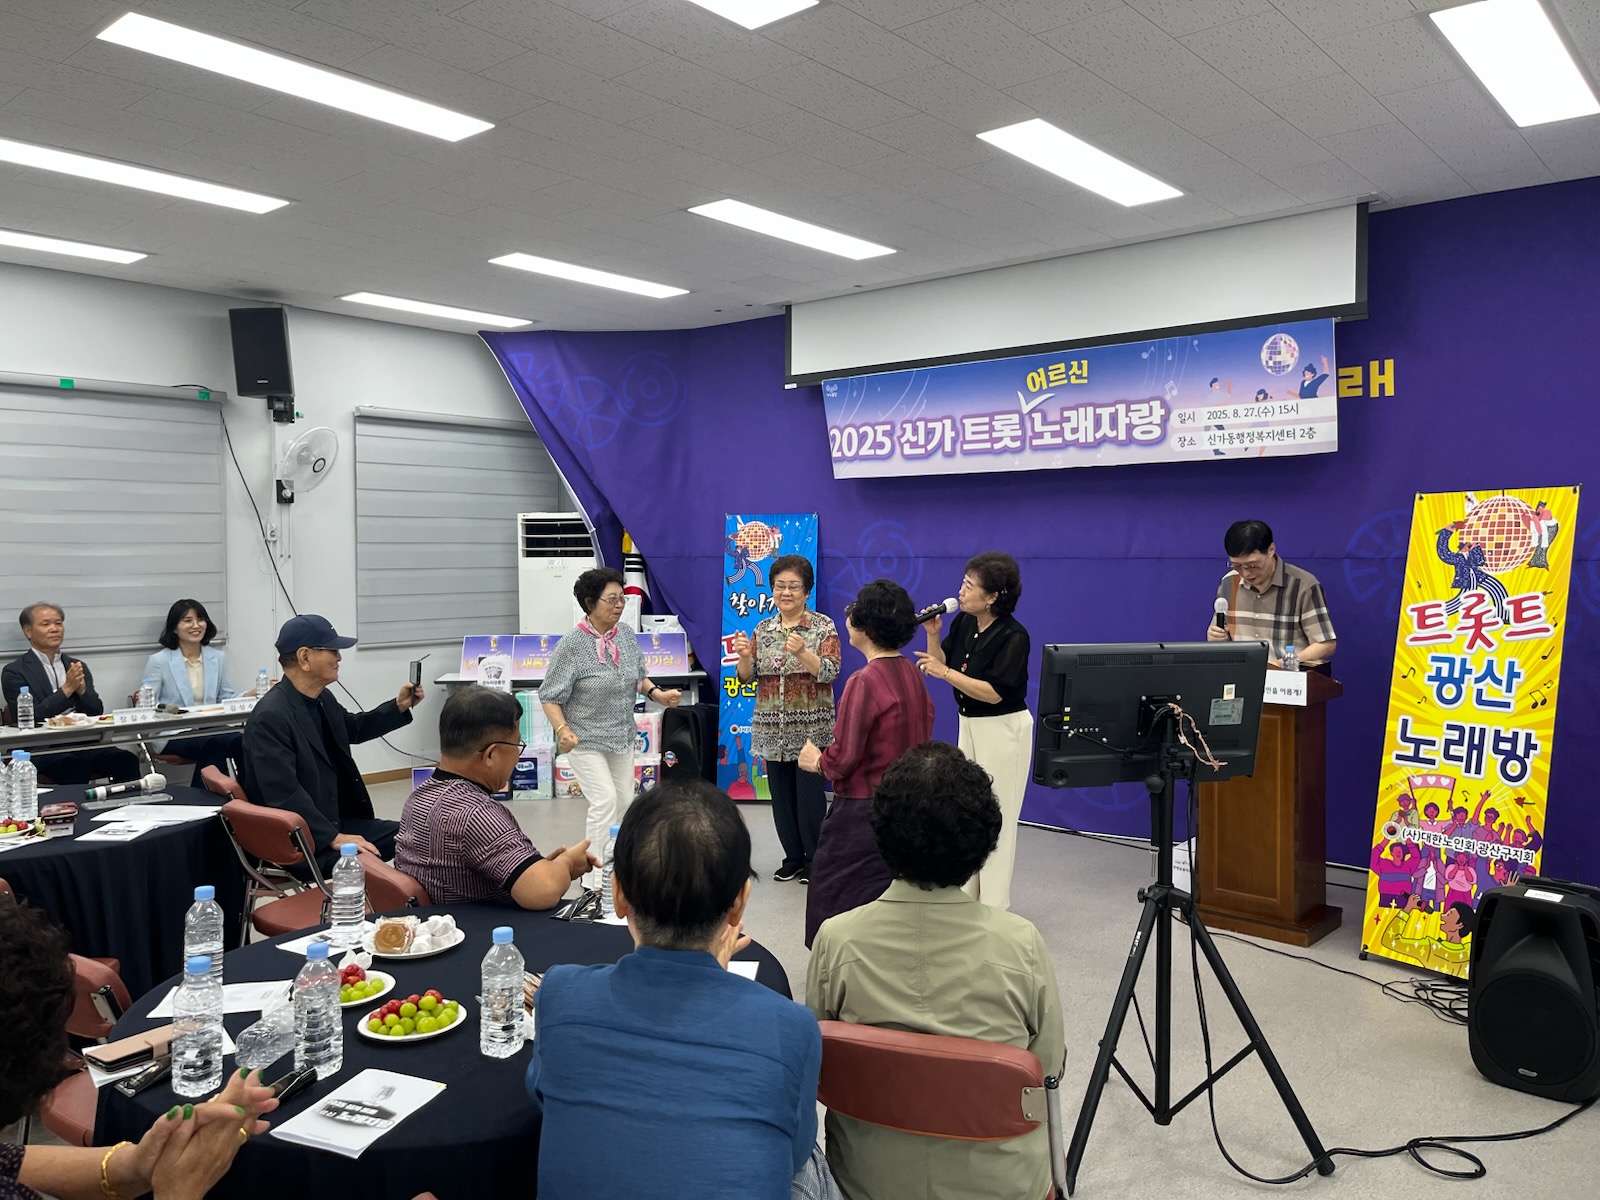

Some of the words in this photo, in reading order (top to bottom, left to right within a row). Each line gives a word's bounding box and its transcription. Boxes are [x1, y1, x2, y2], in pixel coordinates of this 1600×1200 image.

[1026, 360, 1088, 392] 어르신
[1338, 358, 1395, 398] 래
[830, 423, 891, 458] 2025
[900, 418, 955, 455] 신가
[962, 413, 1022, 450] 트롯
[1031, 400, 1165, 446] 노래자랑
[1177, 411, 1196, 425] 일시
[1207, 409, 1230, 420] 2025.
[1232, 409, 1241, 419] 8.
[1243, 405, 1275, 418] 27.(수)
[1278, 403, 1299, 415] 15시
[1177, 435, 1197, 448] 장소
[1207, 428, 1296, 446] 신가동행정복지센터
[1299, 426, 1317, 440] 2층
[1409, 592, 1551, 650] 트롯트
[723, 677, 758, 698] 광산
[1279, 687, 1303, 697] 이롭게!
[1427, 655, 1521, 709] 광산
[1395, 718, 1538, 783] 노래방
[1402, 829, 1475, 851] (사)대한노인회
[1478, 841, 1534, 863] 광산구지회
